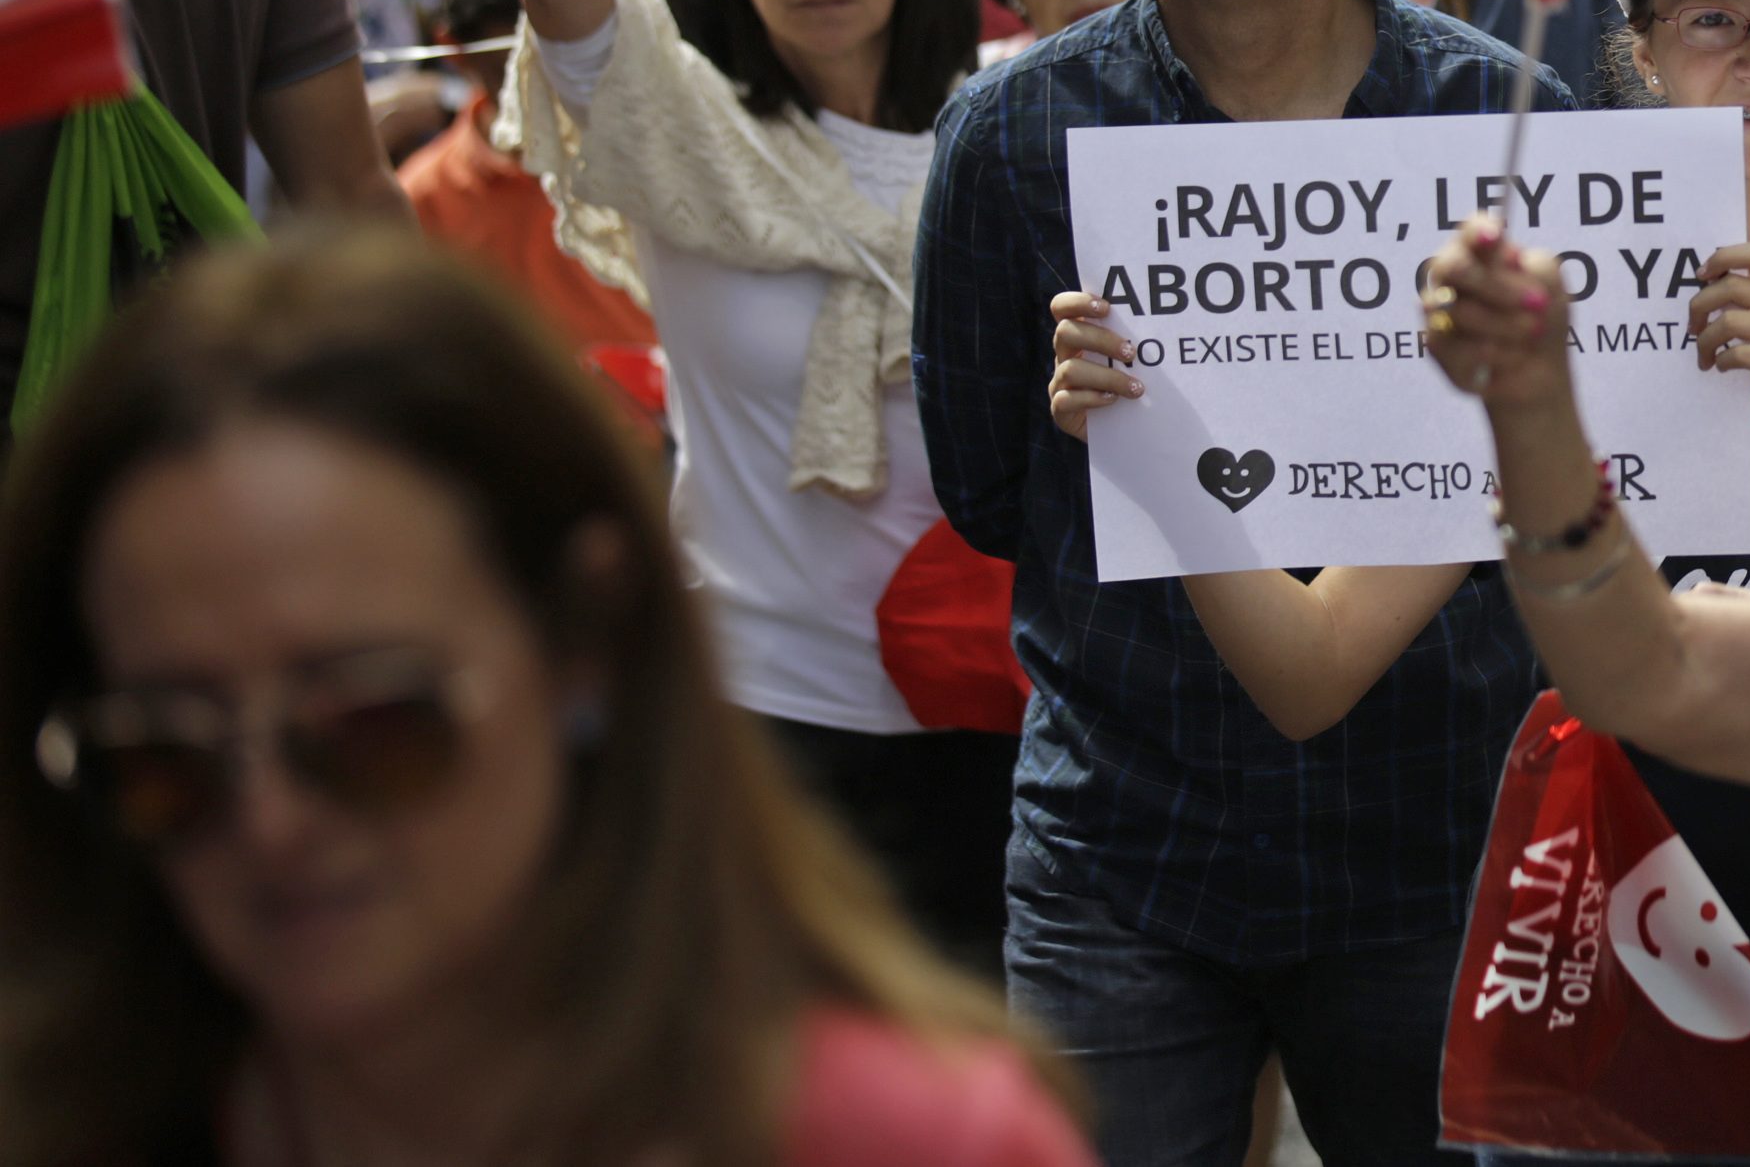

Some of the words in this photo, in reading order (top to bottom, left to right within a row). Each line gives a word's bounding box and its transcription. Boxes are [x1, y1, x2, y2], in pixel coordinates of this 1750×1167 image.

[1155, 180, 1409, 252] ¡RAJOY,
[1579, 171, 1664, 225] DE
[1101, 258, 1391, 316] ABORTO
[1179, 333, 1300, 364] EXISTE
[1313, 332, 1354, 361] EL
[1288, 461, 1471, 500] DERECHO
[1475, 826, 1580, 1021] VIVIR
[1548, 1007, 1576, 1031] A
